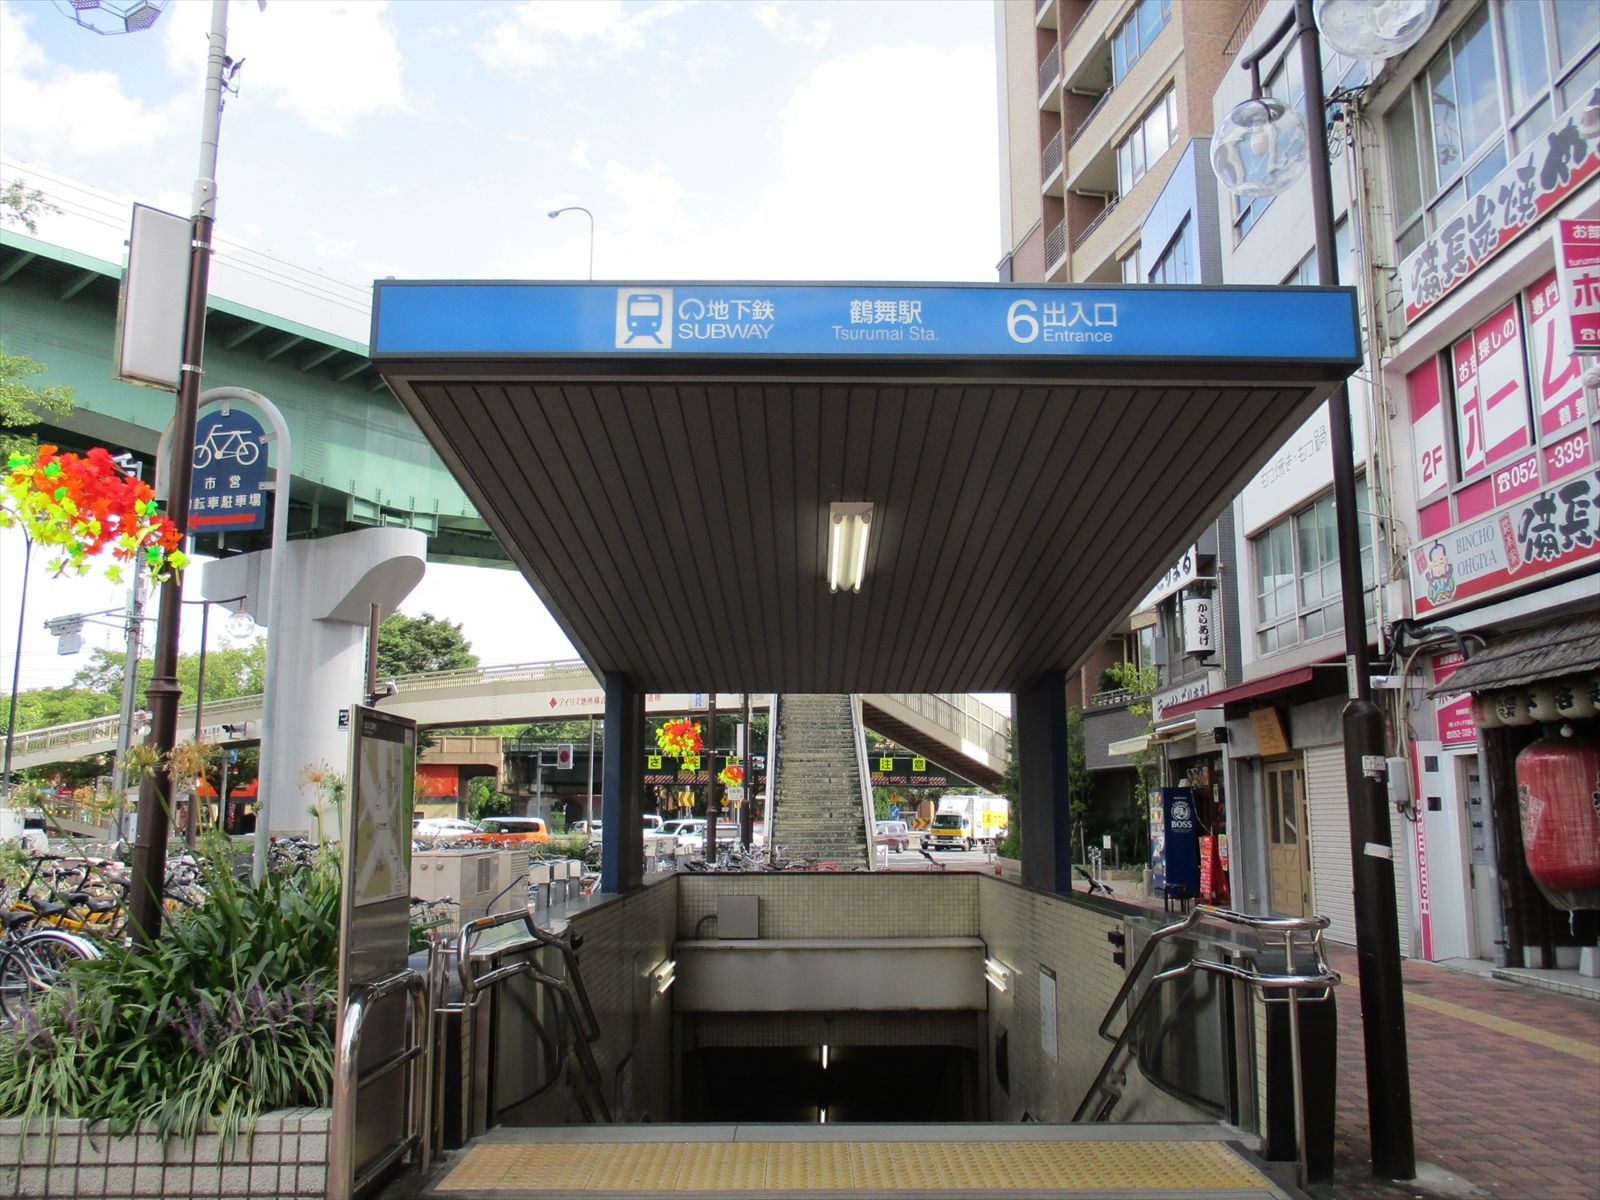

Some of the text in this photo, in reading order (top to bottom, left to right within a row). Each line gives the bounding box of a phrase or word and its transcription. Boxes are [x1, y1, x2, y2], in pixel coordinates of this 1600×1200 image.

[706, 299, 775, 321] 地下鉄
[849, 299, 923, 325] 鶴舞駅
[1006, 299, 1040, 344] 6
[1042, 301, 1118, 328] 出入口
[678, 322, 775, 340] SUBWAY
[832, 325, 940, 342] Tsurumai Sta.
[1043, 328, 1113, 343] Entrance
[1421, 444, 1443, 484] 2F
[204, 475, 242, 491] 市営
[190, 493, 262, 511] 転車駐車場
[1517, 470, 1600, 563] 備長
[1457, 550, 1498, 577] OHGIYA
[1197, 603, 1210, 646] からあげ
[1171, 820, 1193, 829] BOSS
